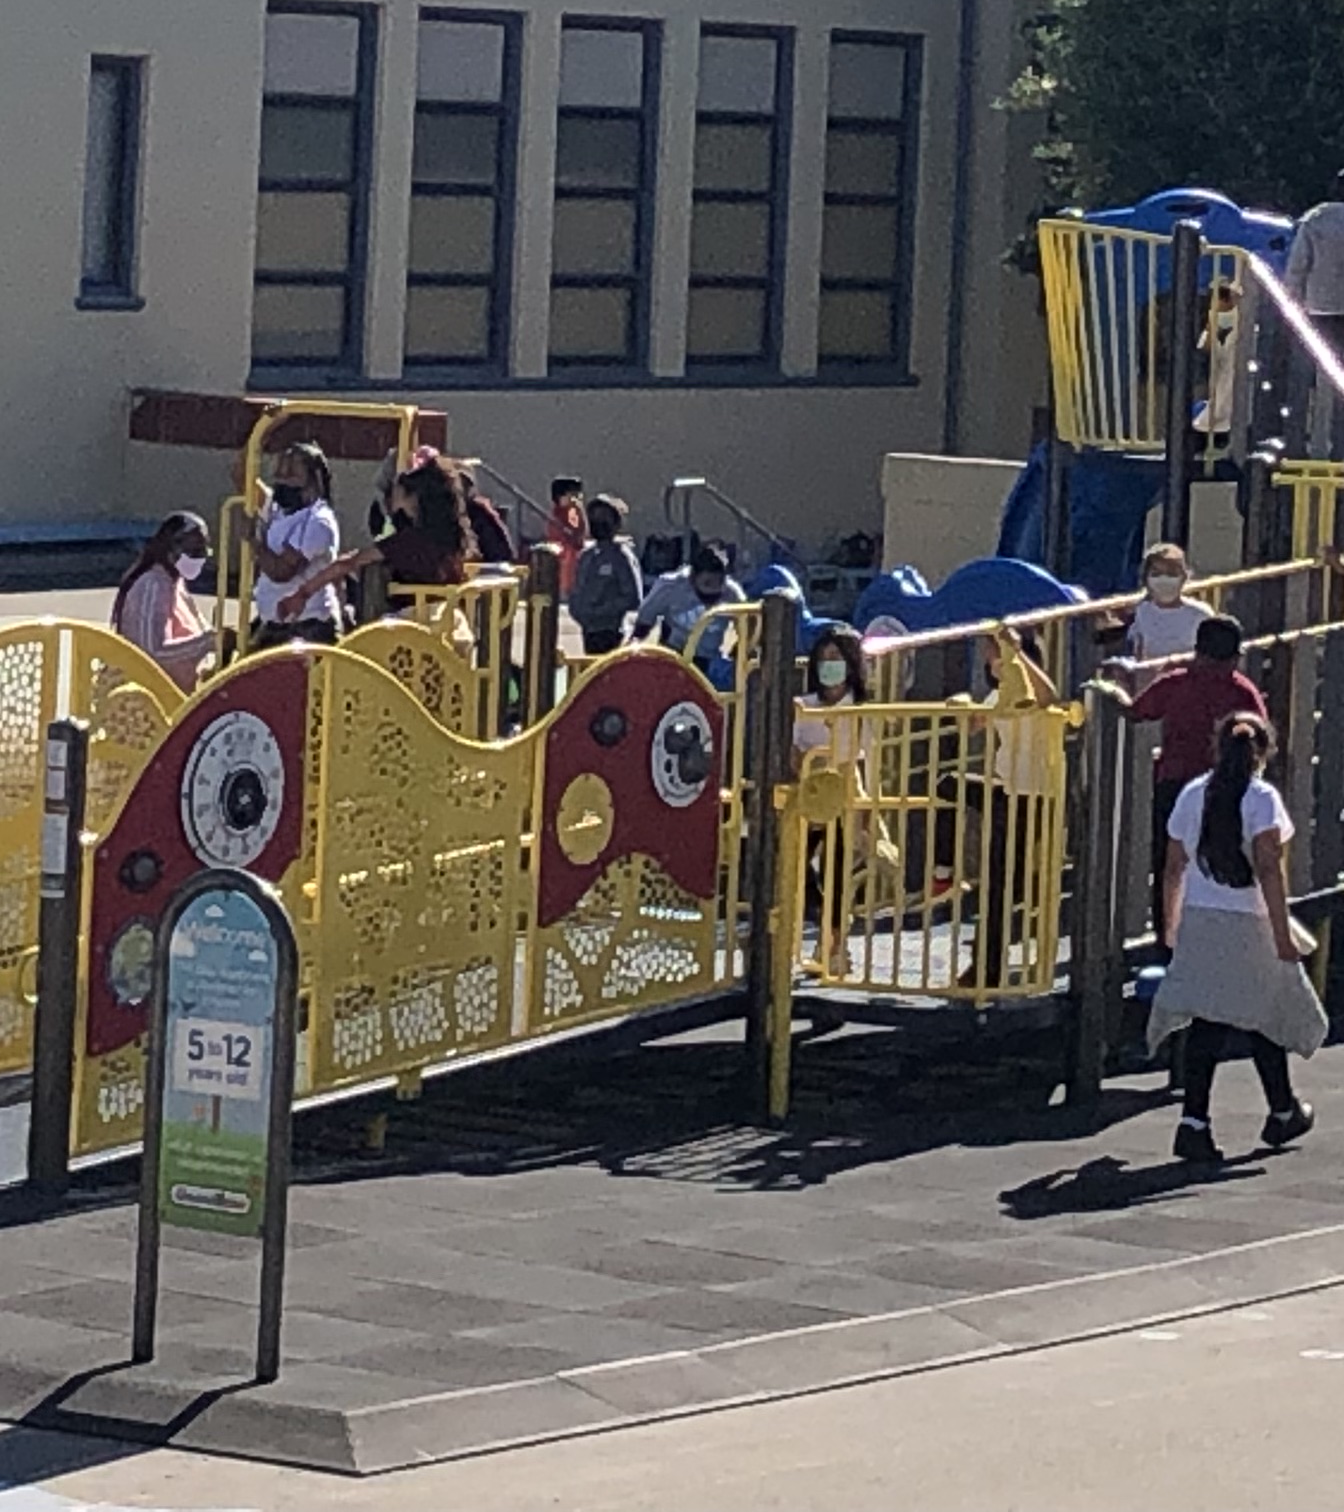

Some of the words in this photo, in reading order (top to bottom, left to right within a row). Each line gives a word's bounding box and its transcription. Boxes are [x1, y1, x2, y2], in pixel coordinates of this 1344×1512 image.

[187, 1028, 204, 1061] 5
[207, 1040, 223, 1056] to
[222, 1033, 252, 1067] 12
[187, 1069, 223, 1082] years
[226, 1070, 249, 1087] old
